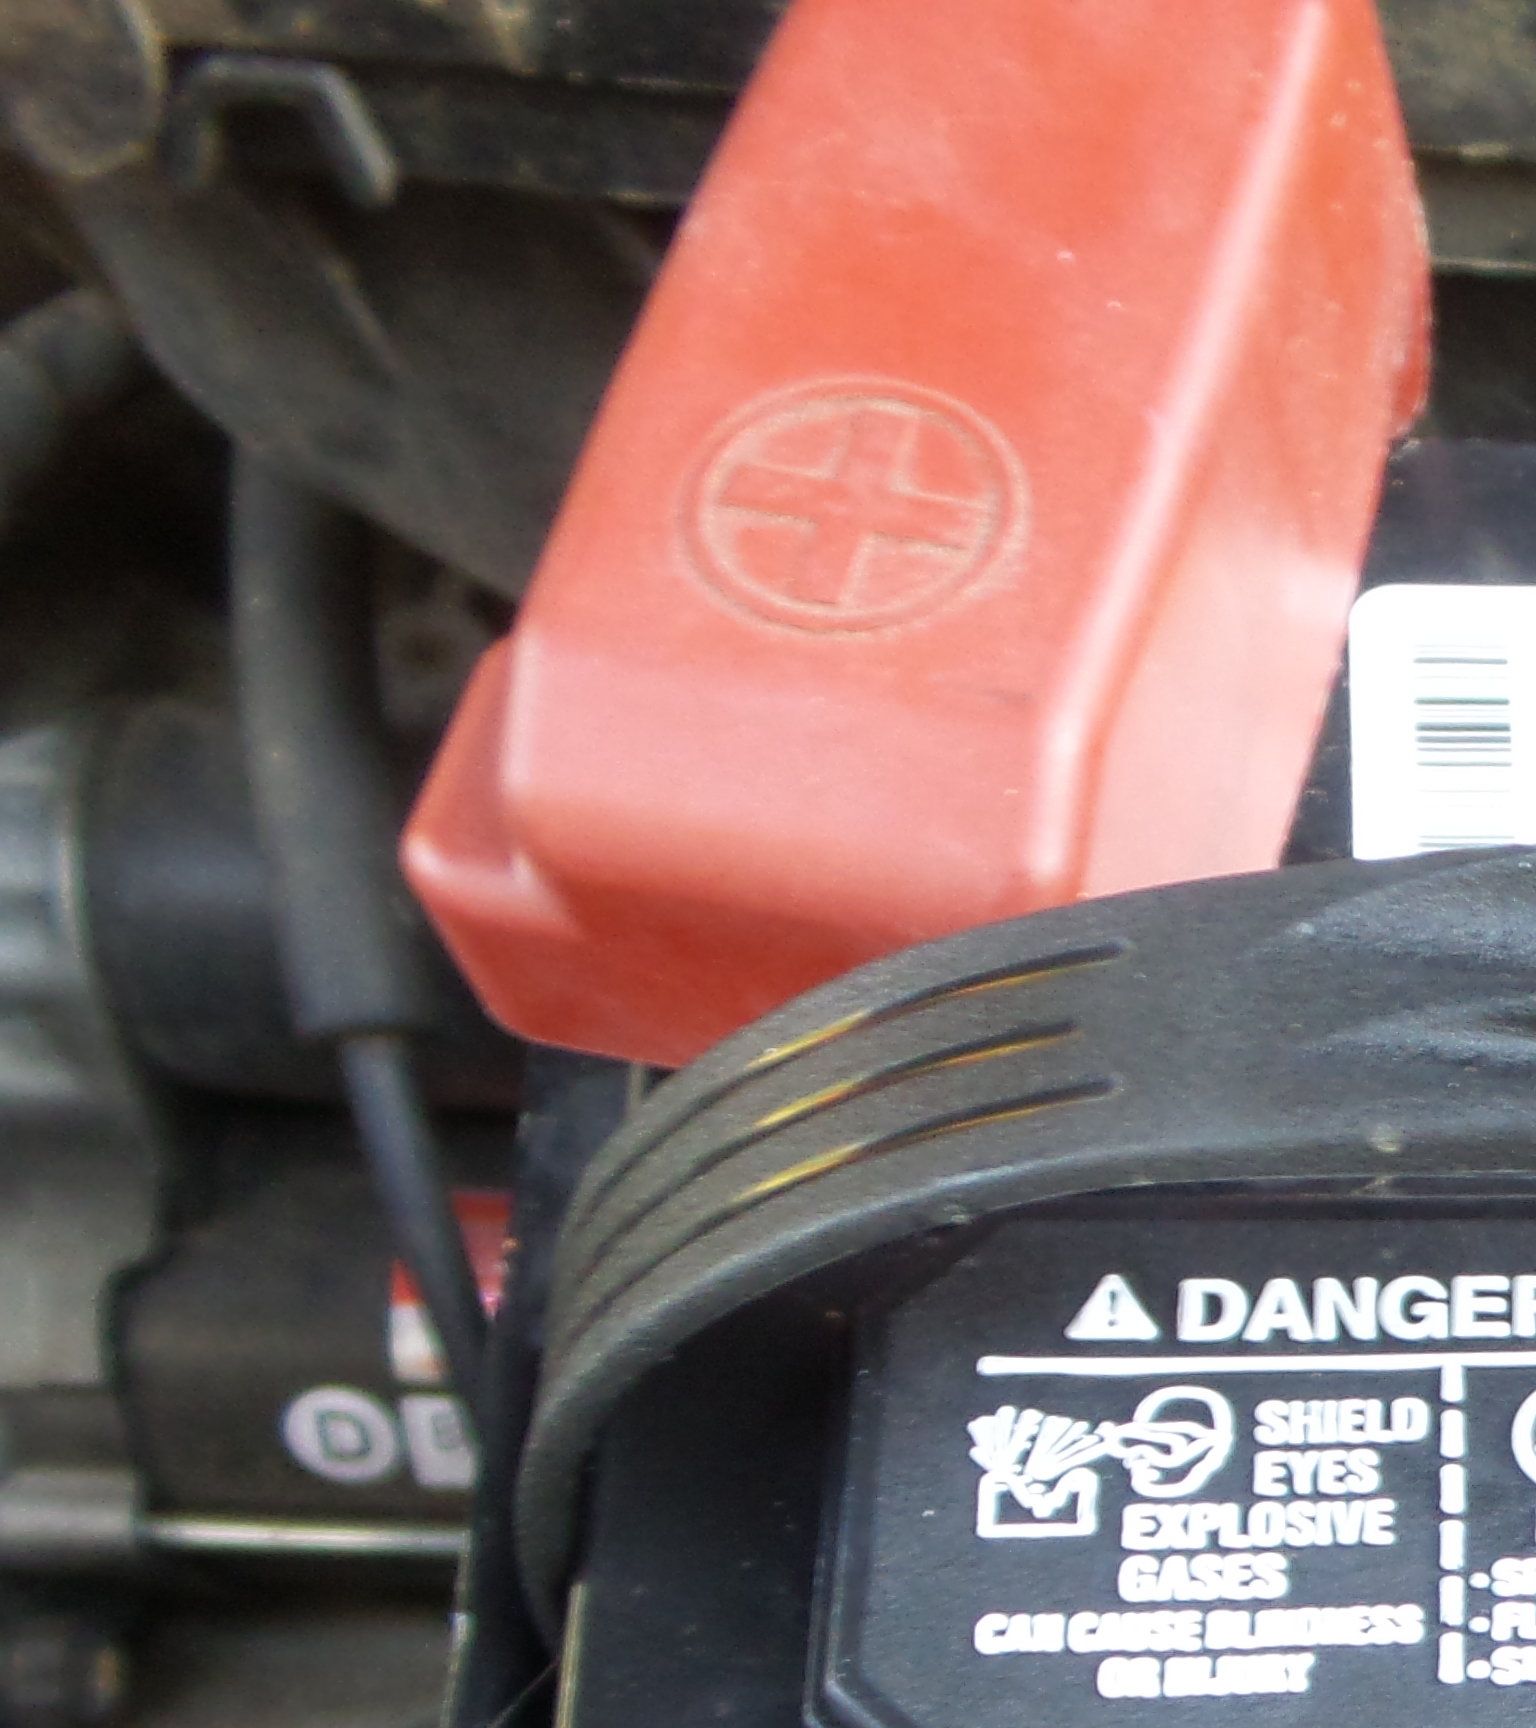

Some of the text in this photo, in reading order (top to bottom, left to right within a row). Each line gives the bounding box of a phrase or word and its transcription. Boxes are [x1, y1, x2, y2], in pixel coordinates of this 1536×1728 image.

[1253, 1398, 1430, 1445] SHIELD
[1253, 1449, 1381, 1496] EYES
[1121, 1499, 1396, 1550] EXPLOSIVE
[1118, 1553, 1289, 1603] GASES
[974, 1613, 1065, 1655] CAN
